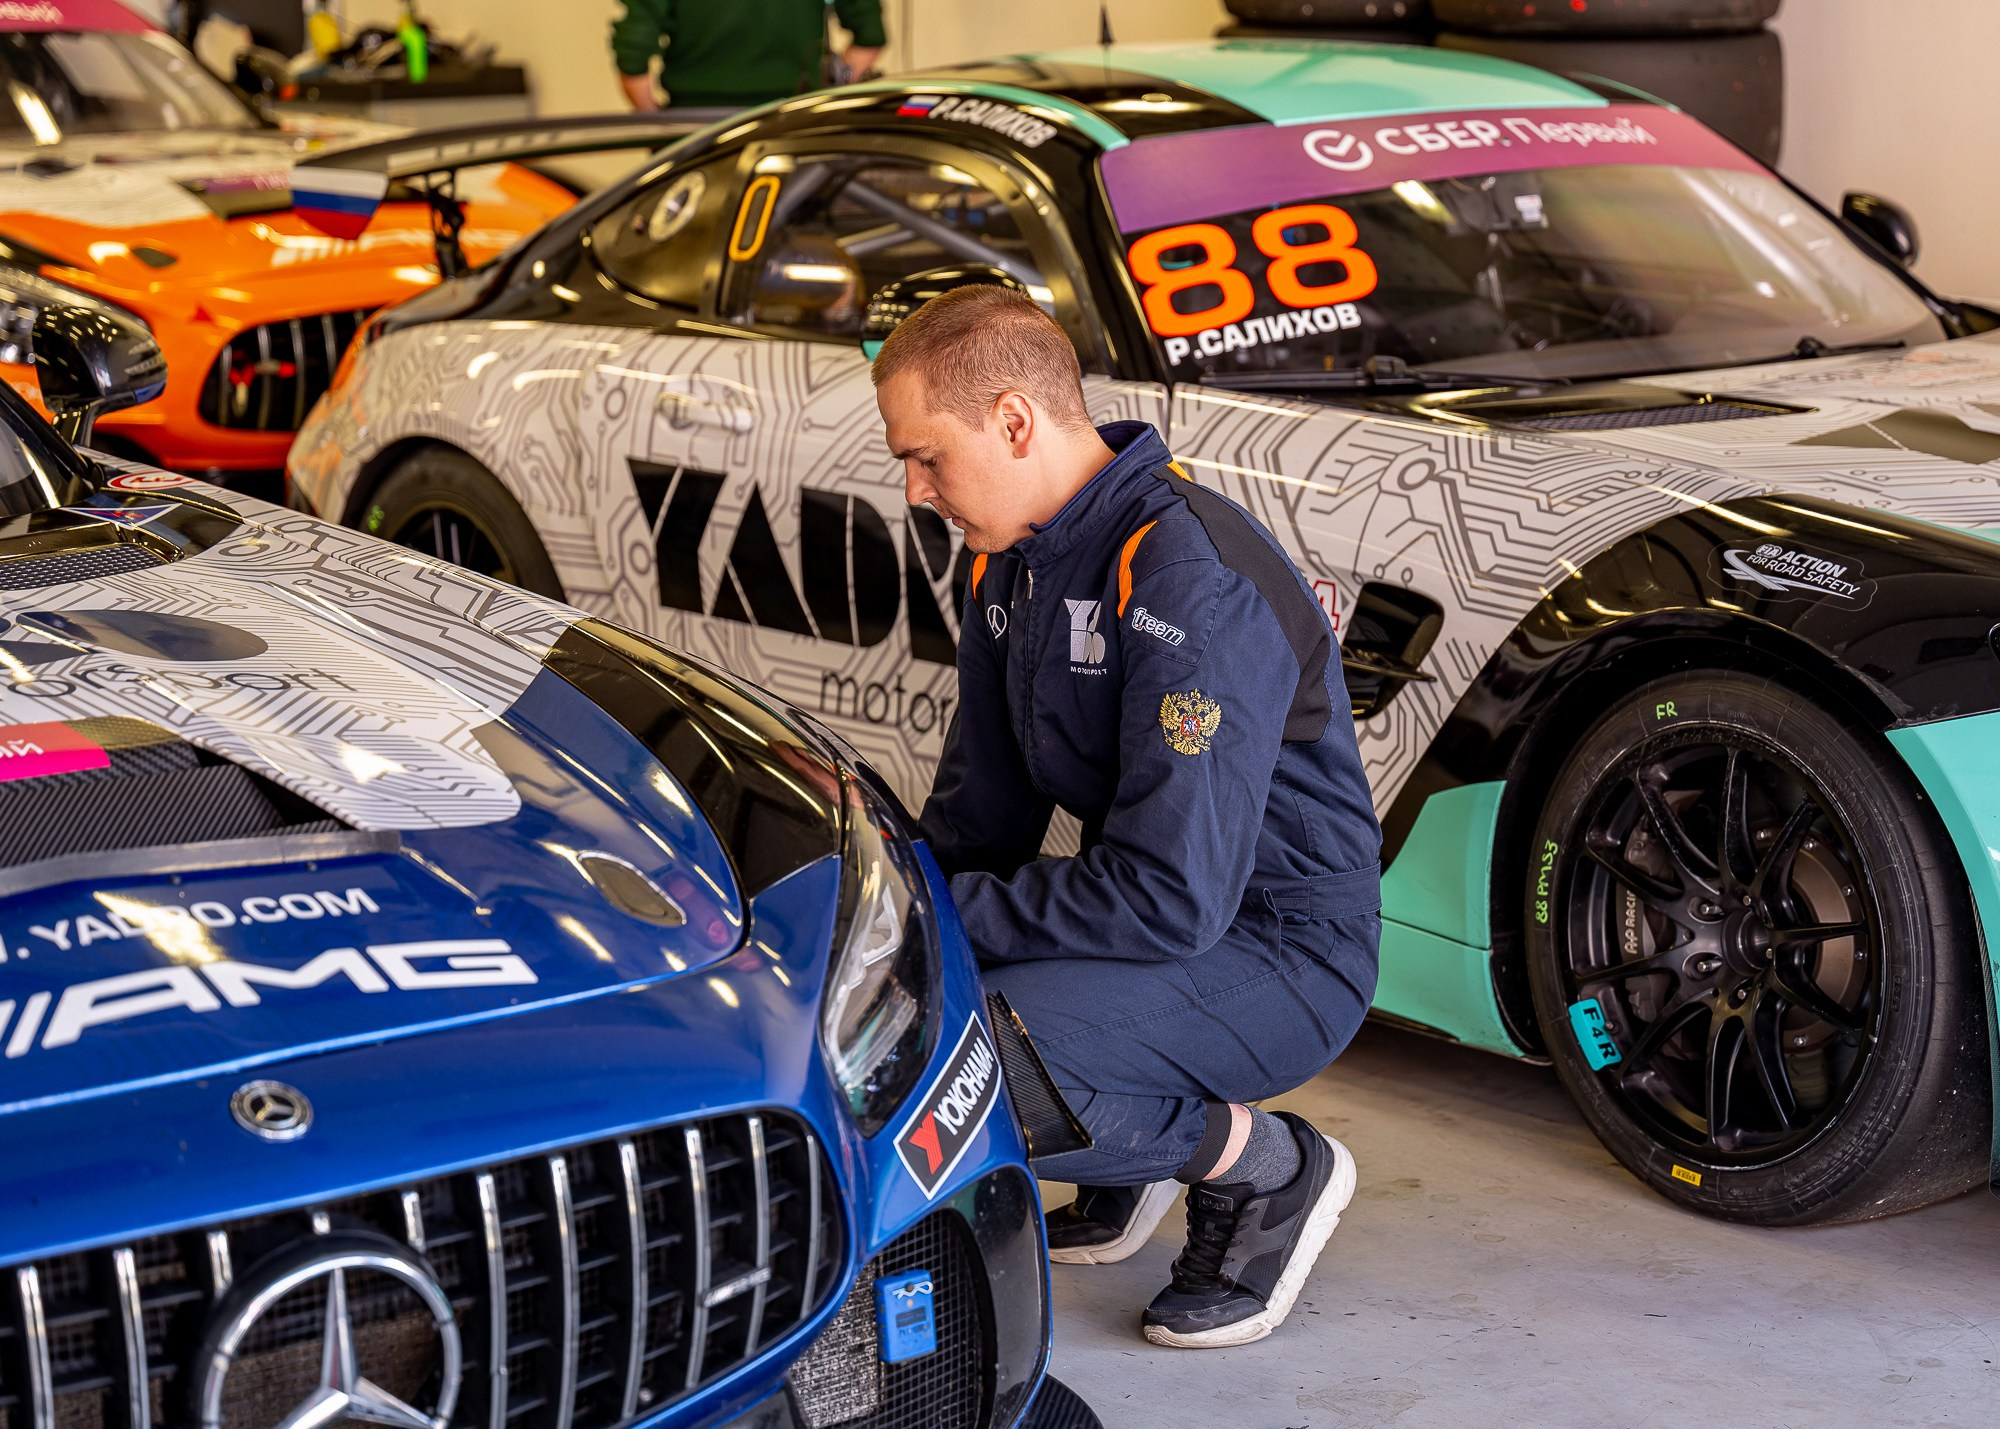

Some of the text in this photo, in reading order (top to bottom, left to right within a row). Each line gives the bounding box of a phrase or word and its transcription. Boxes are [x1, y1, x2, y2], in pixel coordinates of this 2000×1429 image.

[1502, 117, 1657, 148] Первый
[1128, 204, 1378, 338] 88
[1164, 302, 1362, 366] Р.САЛИХОВ
[622, 457, 966, 668] YADR
[1746, 554, 1861, 596] FOR ROAD SAFETY
[1778, 550, 1847, 578] ACTION
[1656, 701, 1678, 720] FR
[0, 888, 380, 964] .YADO.COM
[933, 1036, 994, 1136] YOKOHAMA
